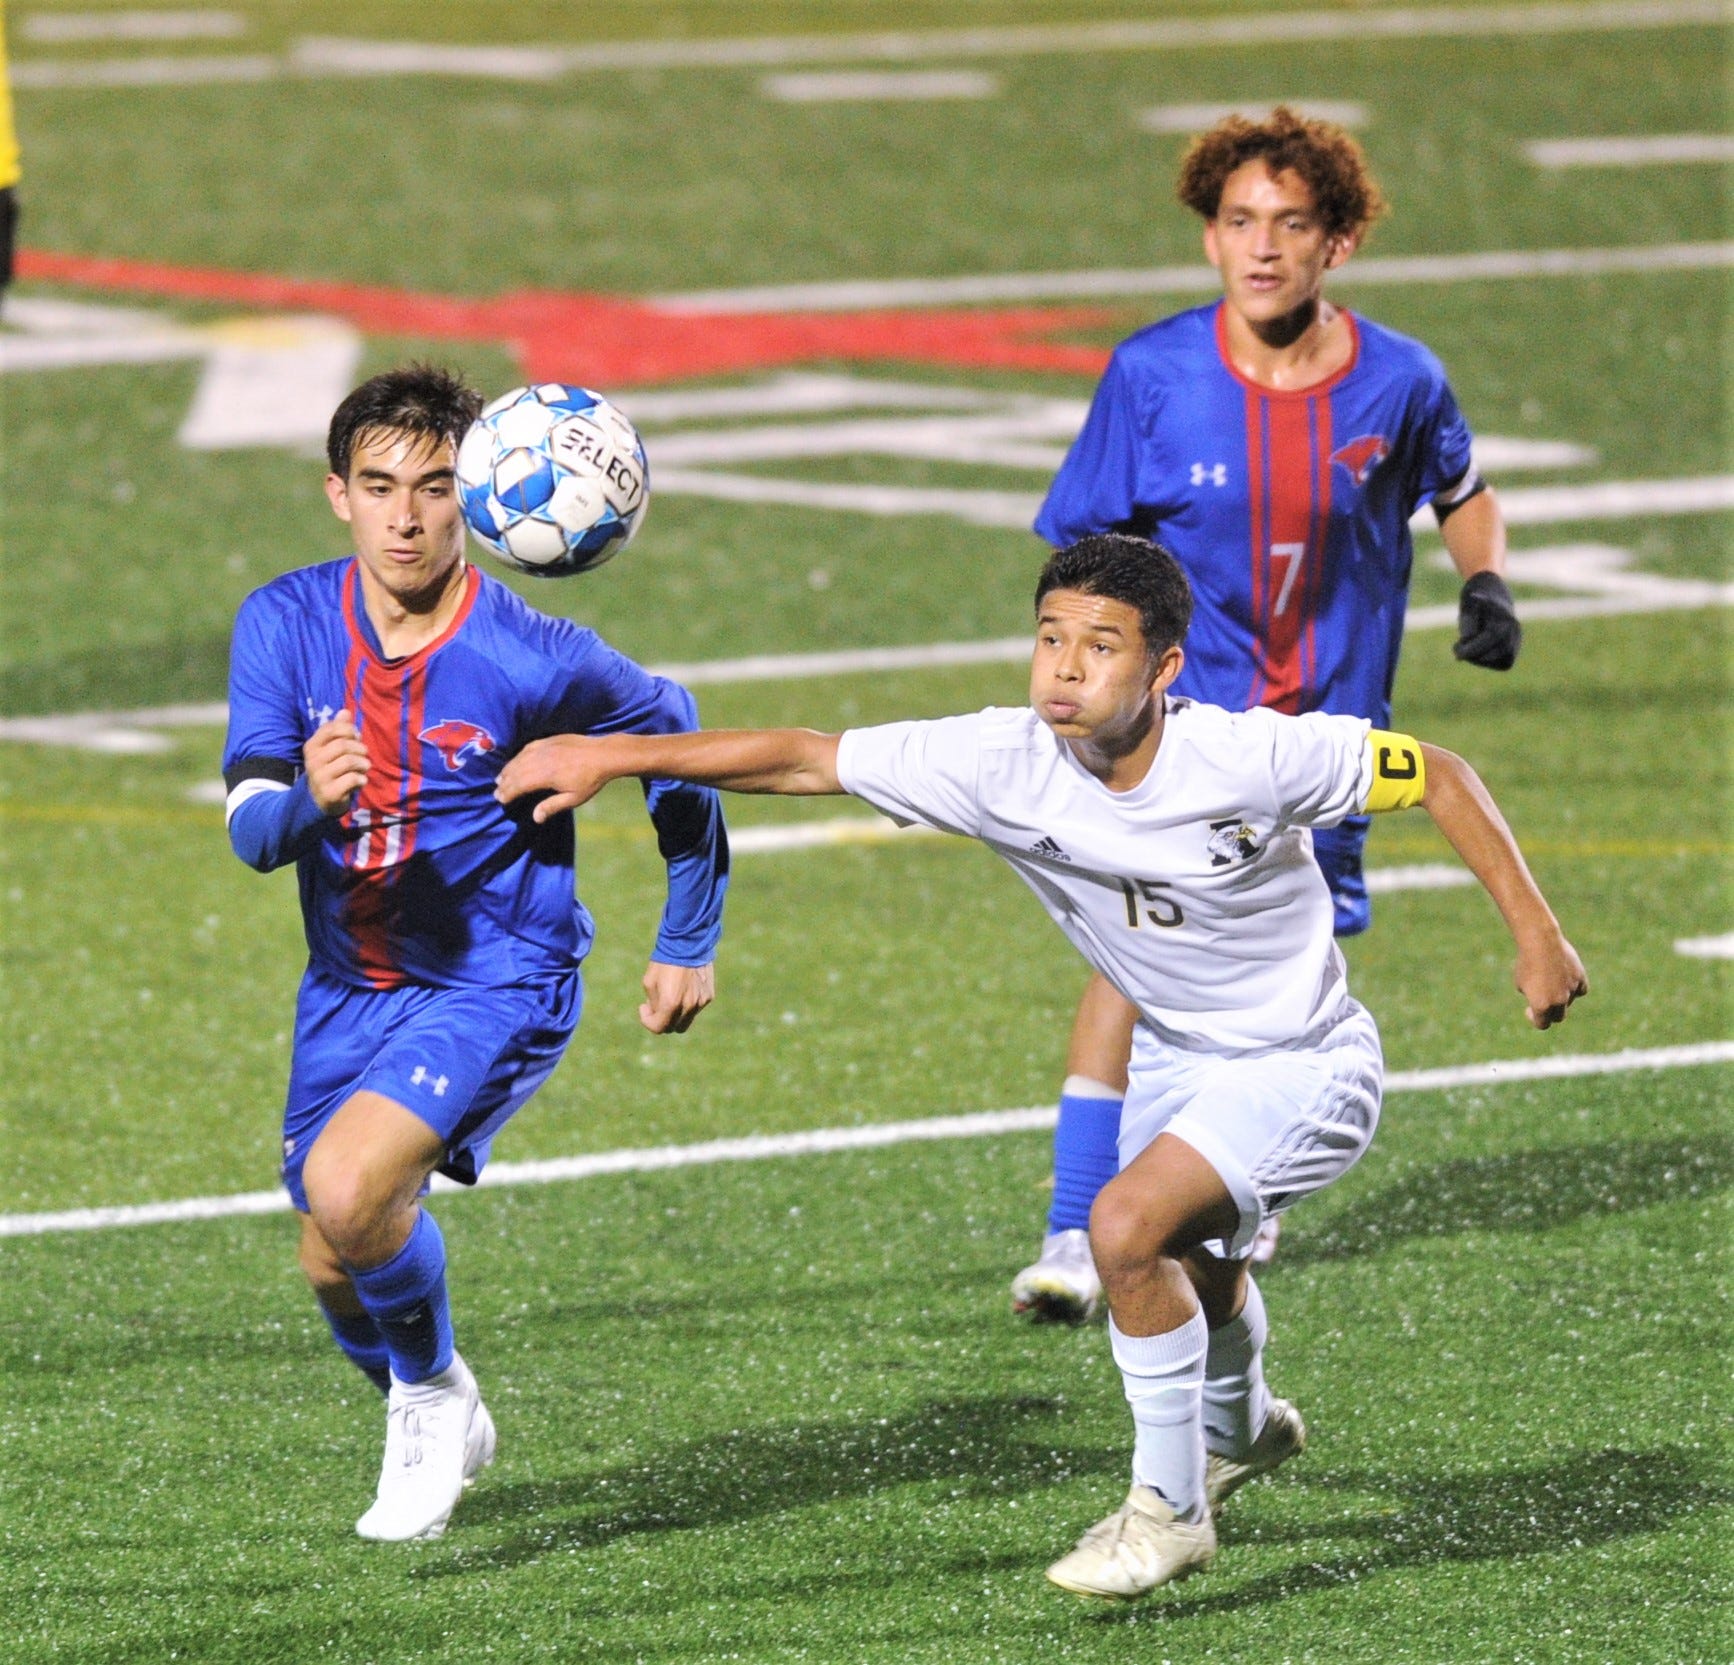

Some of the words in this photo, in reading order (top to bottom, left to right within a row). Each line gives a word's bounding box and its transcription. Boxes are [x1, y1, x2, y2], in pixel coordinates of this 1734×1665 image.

[560, 428, 640, 501] SELECT
[1269, 542, 1305, 616] 7
[1379, 747, 1417, 780] C
[351, 808, 402, 869] 11
[1112, 874, 1185, 929] 15
